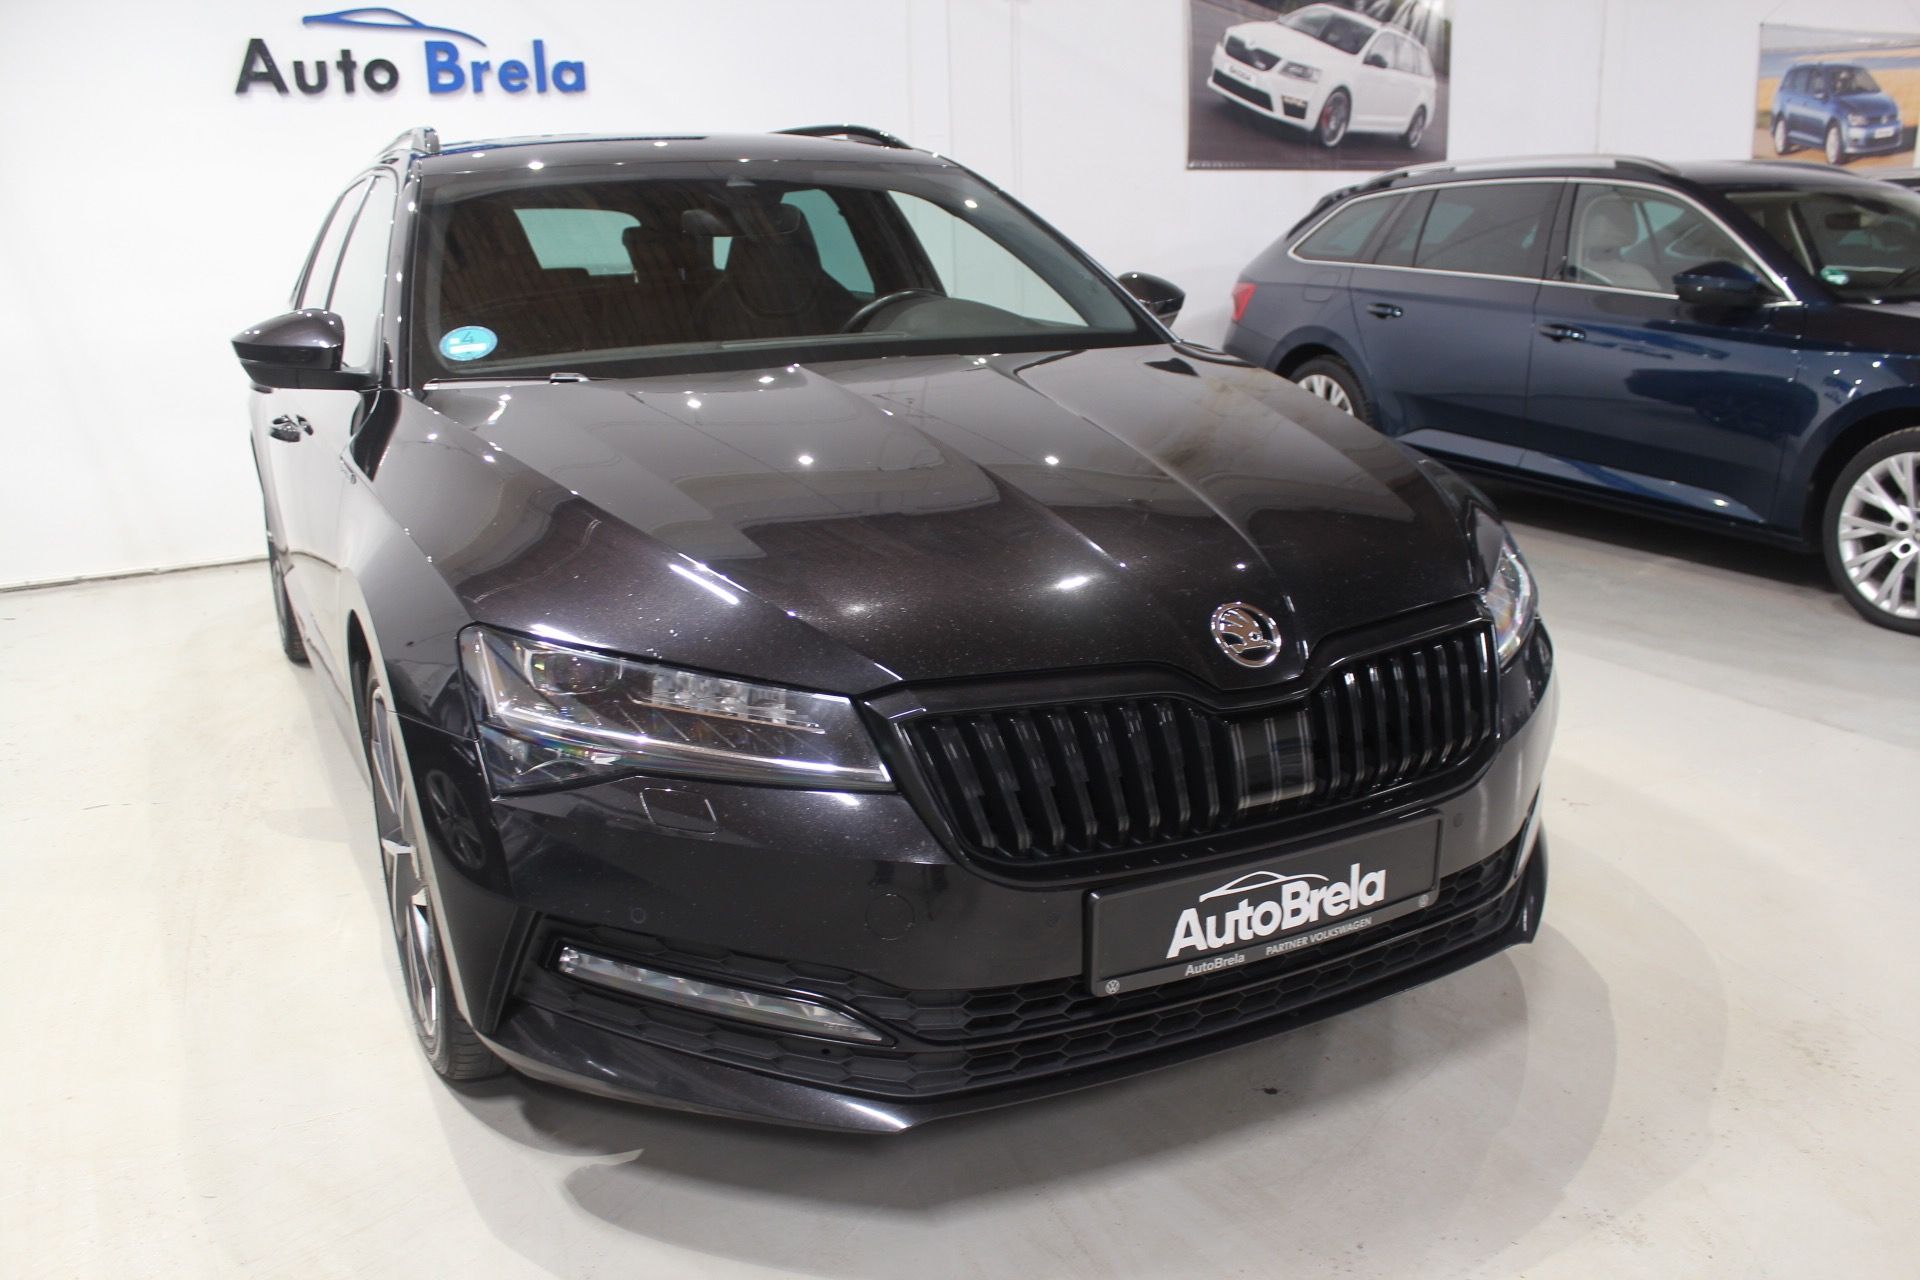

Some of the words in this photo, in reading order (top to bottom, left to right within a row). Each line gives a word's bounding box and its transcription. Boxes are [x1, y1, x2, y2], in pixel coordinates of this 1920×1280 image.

[235, 38, 400, 95] Auto
[424, 39, 587, 95] Brela
[461, 331, 475, 344] 4
[1166, 863, 1387, 959] AutoBrela
[1265, 937, 1309, 956] PARTNER
[1309, 916, 1373, 943] VOLKSWAGEN
[1185, 953, 1246, 977] AutoBrela
